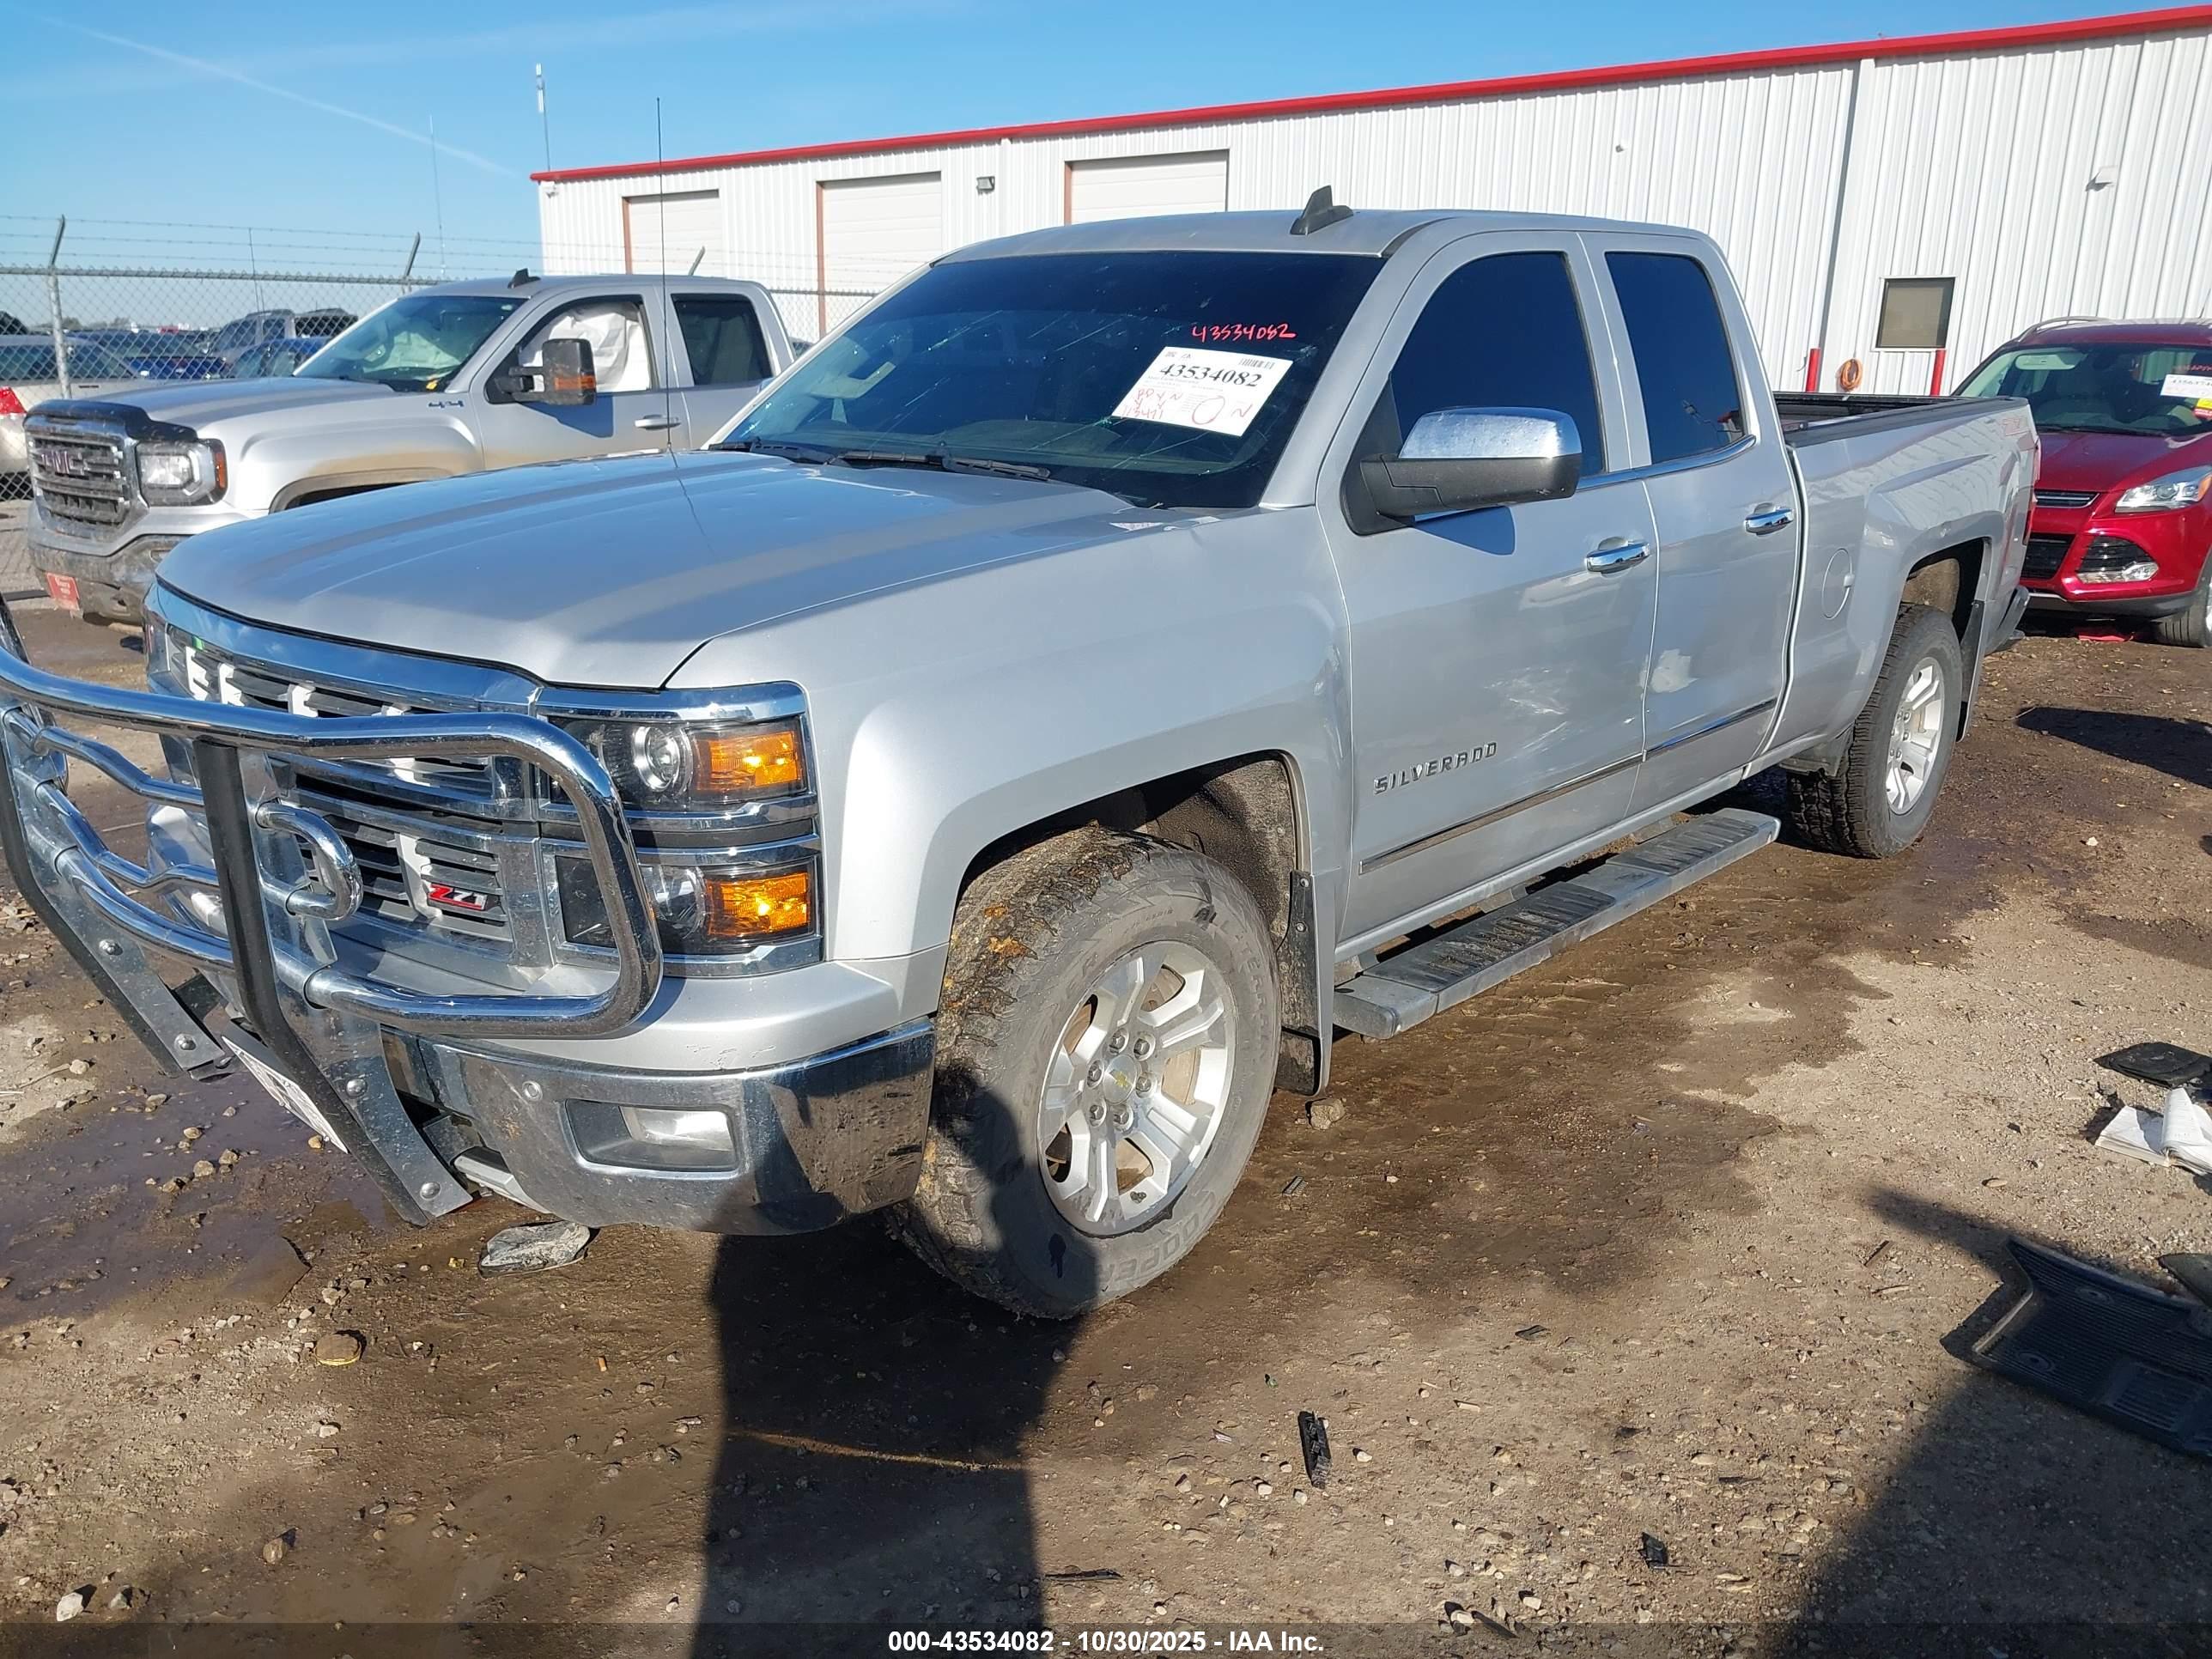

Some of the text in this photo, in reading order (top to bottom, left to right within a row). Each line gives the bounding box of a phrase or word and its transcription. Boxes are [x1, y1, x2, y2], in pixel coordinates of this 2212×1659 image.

[1191, 323, 1297, 343] 43534082
[1159, 363, 1262, 387] 43534082
[1374, 741, 1498, 795] SILVERADO
[428, 883, 488, 911] Z71
